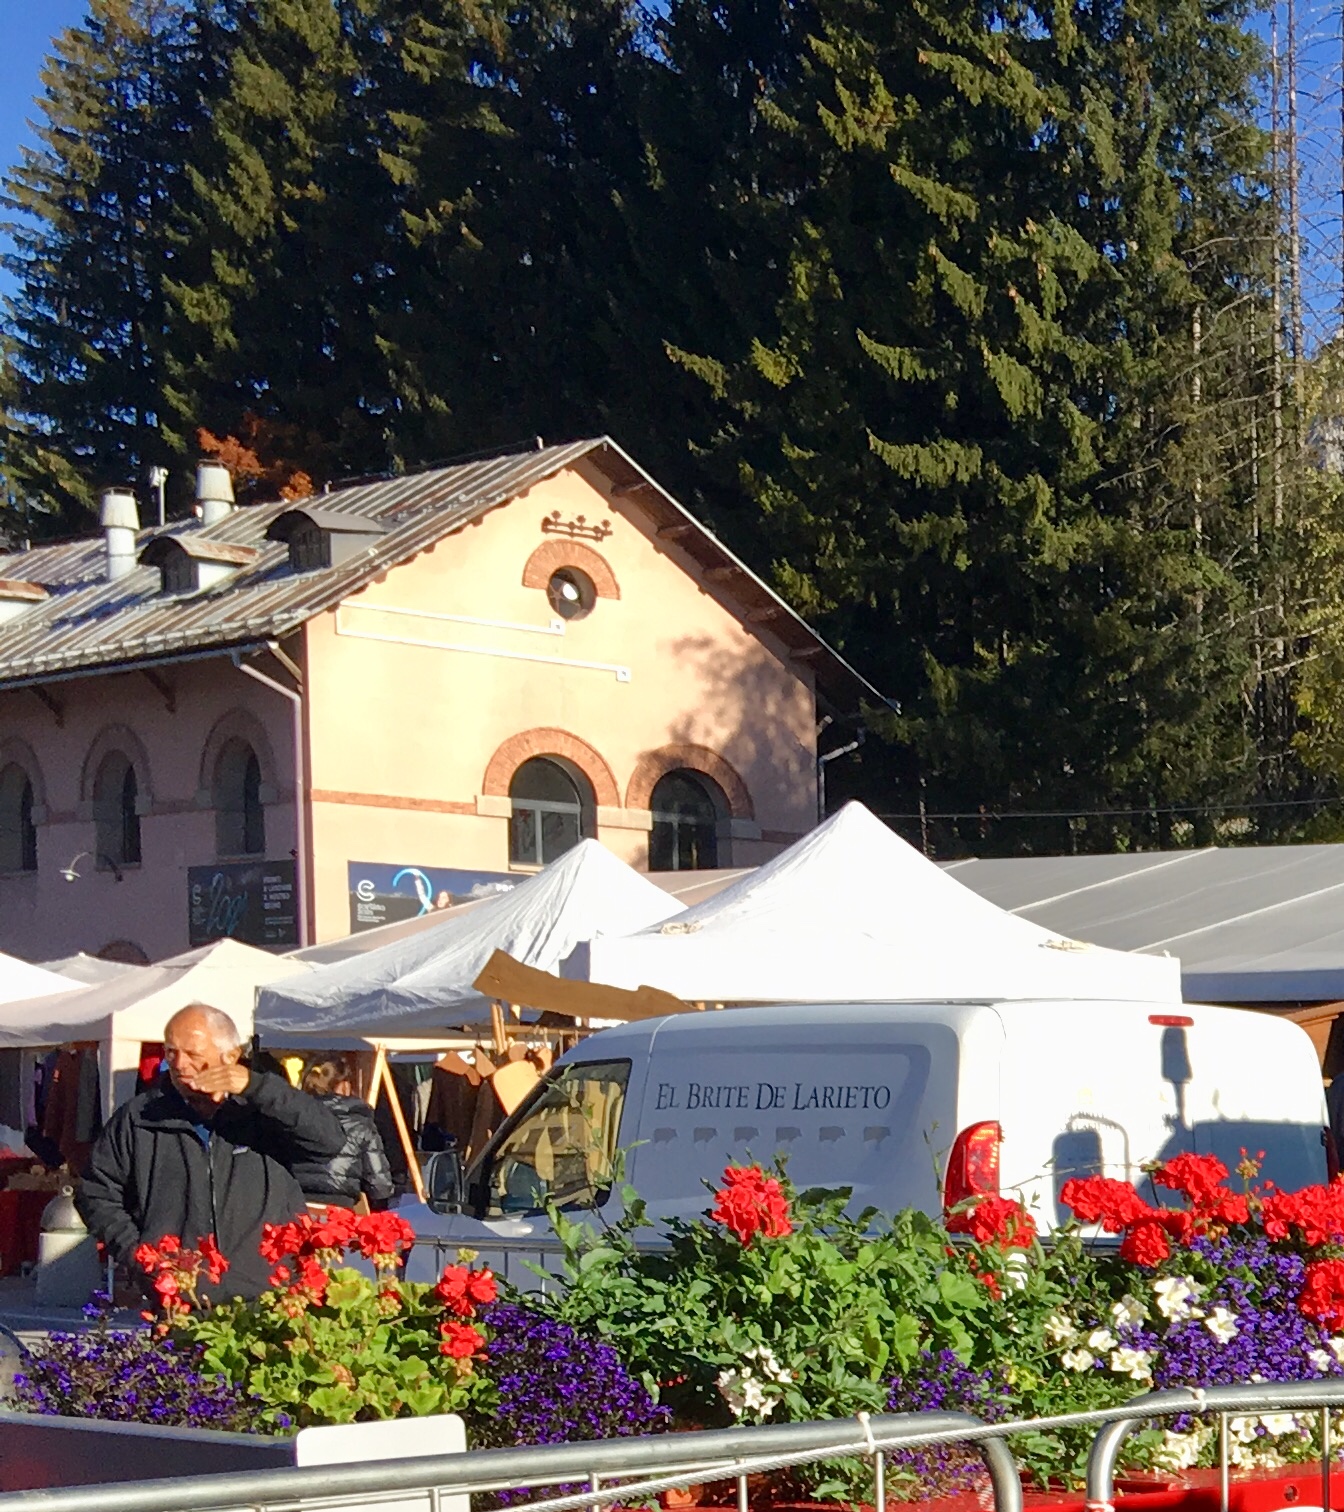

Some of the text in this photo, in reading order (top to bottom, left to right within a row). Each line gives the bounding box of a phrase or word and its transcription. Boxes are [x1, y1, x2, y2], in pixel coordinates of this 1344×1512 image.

[655, 1083, 891, 1110] EL BRITE DE LARIETO
